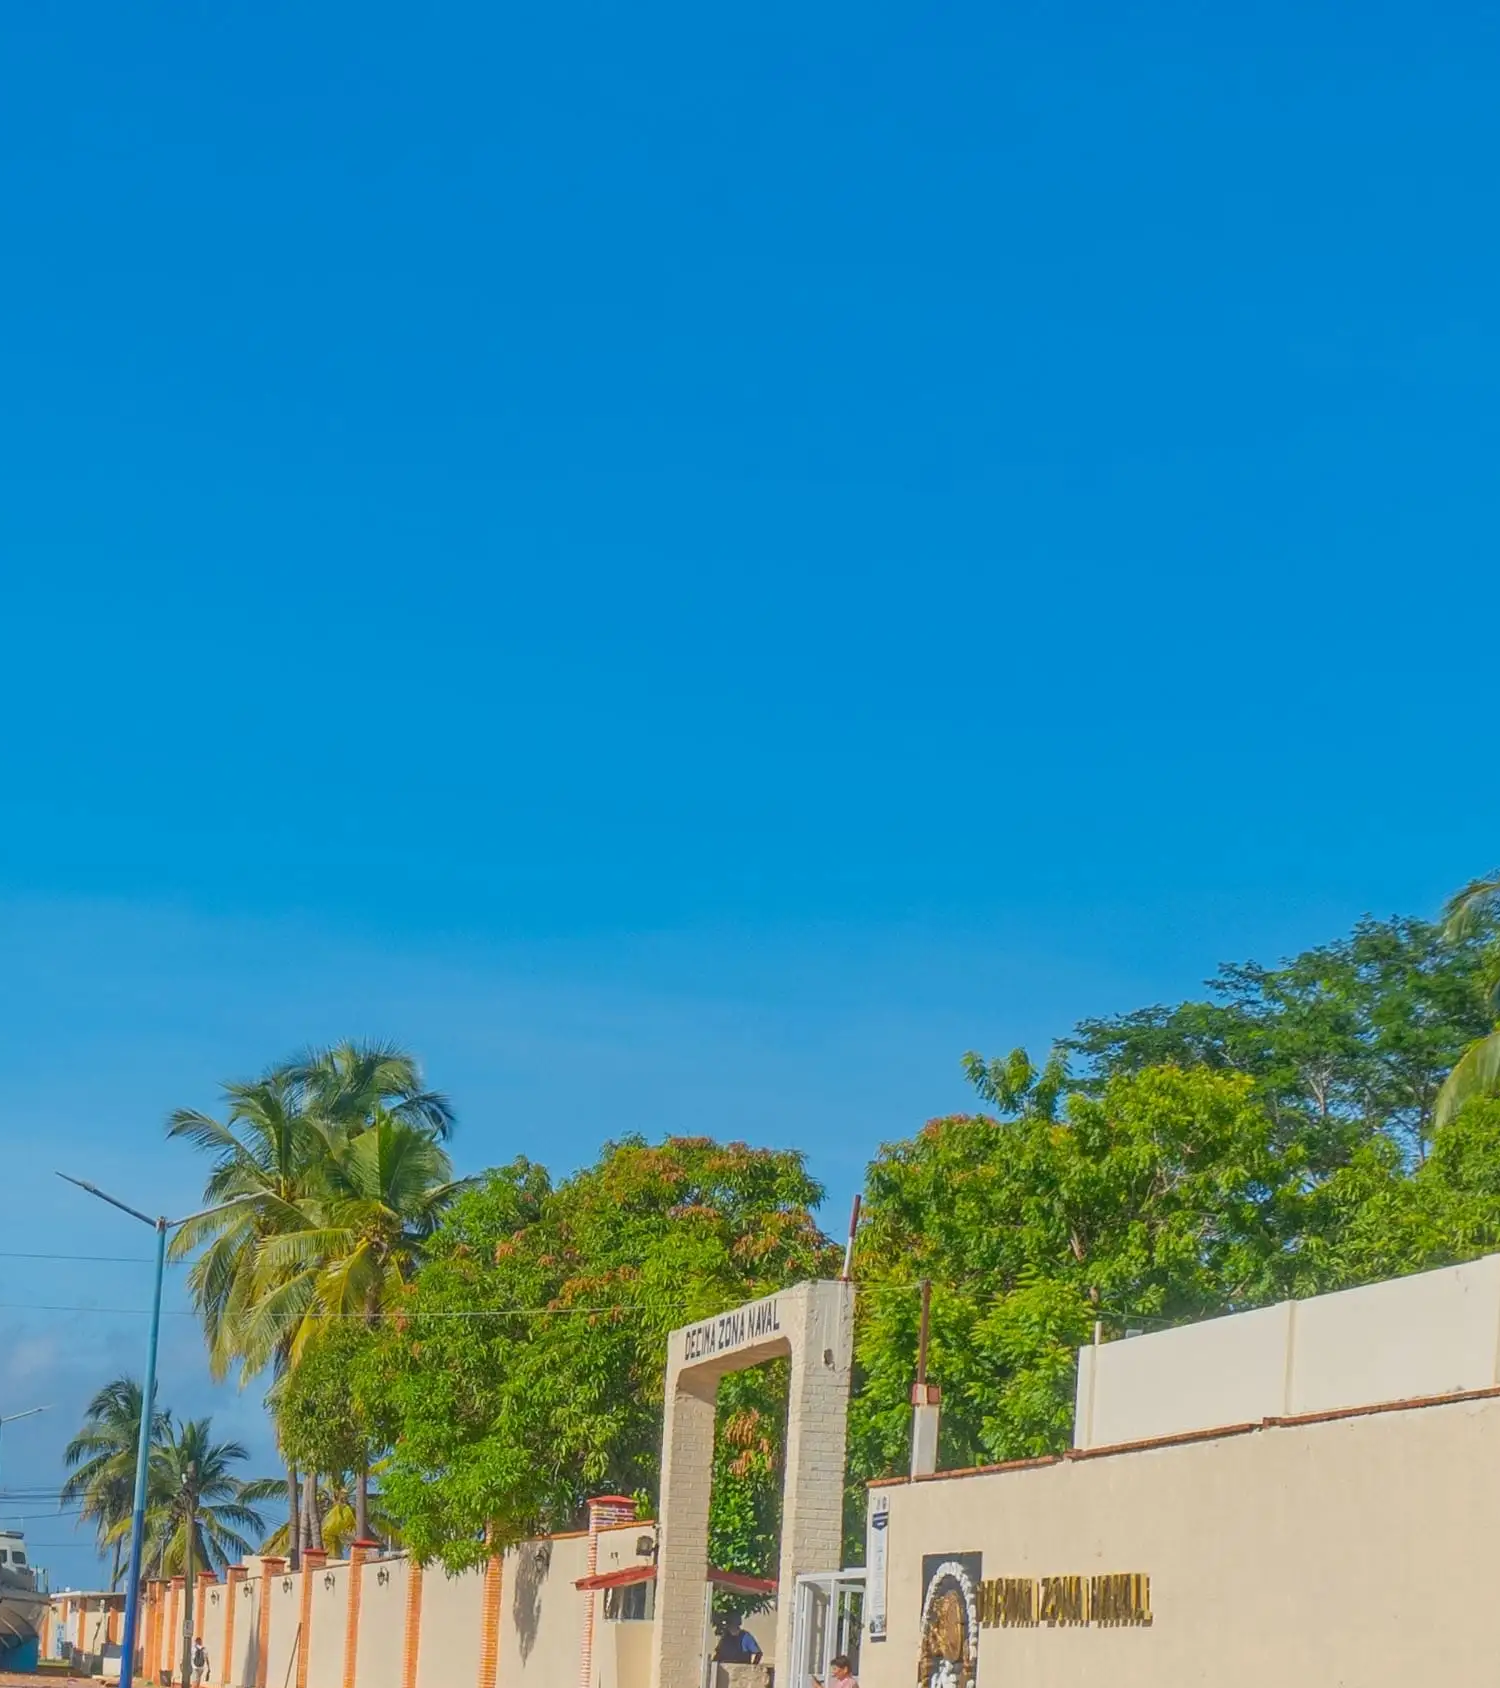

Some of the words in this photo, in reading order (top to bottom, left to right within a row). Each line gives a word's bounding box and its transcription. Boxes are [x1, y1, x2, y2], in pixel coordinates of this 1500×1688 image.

[685, 1323, 716, 1361] DECIMA
[719, 1312, 745, 1350] ZONA
[747, 1299, 780, 1341] NAVAL
